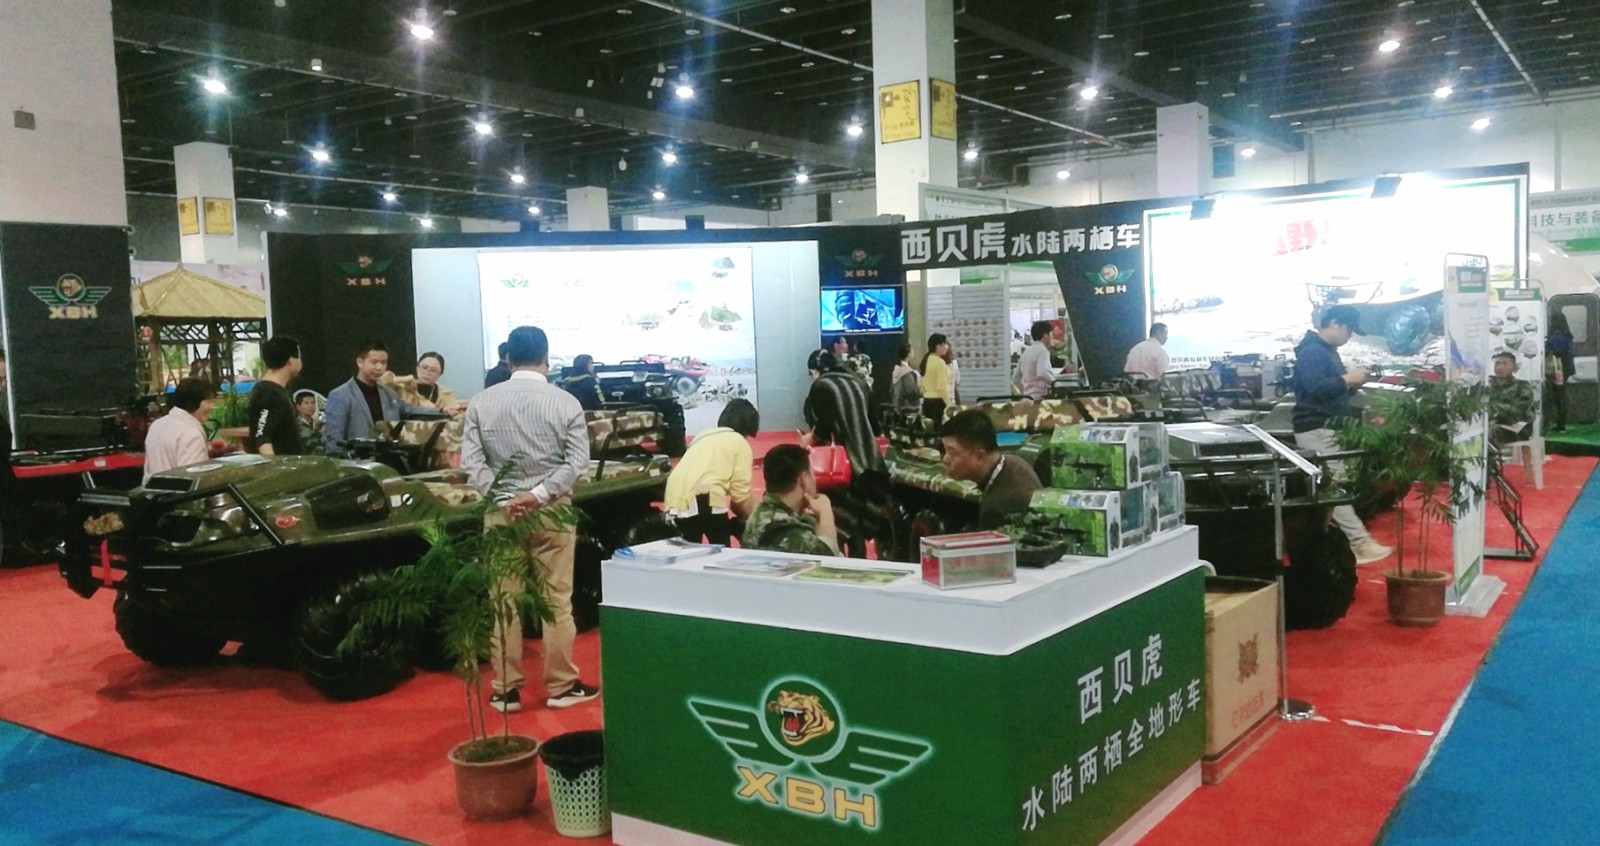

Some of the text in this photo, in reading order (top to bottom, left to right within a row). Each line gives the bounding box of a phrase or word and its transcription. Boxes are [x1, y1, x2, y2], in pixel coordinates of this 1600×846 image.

[901, 221, 1140, 265] 西贝虎 水陆两栖车
[346, 277, 386, 286] XBH
[844, 269, 878, 278] XBH
[1094, 284, 1127, 295] XBH
[48, 305, 98, 320] XBH
[1077, 633, 1163, 725] 西贝虎
[1021, 678, 1201, 832] 水陆两栖全地形车
[737, 765, 876, 828] XBH
